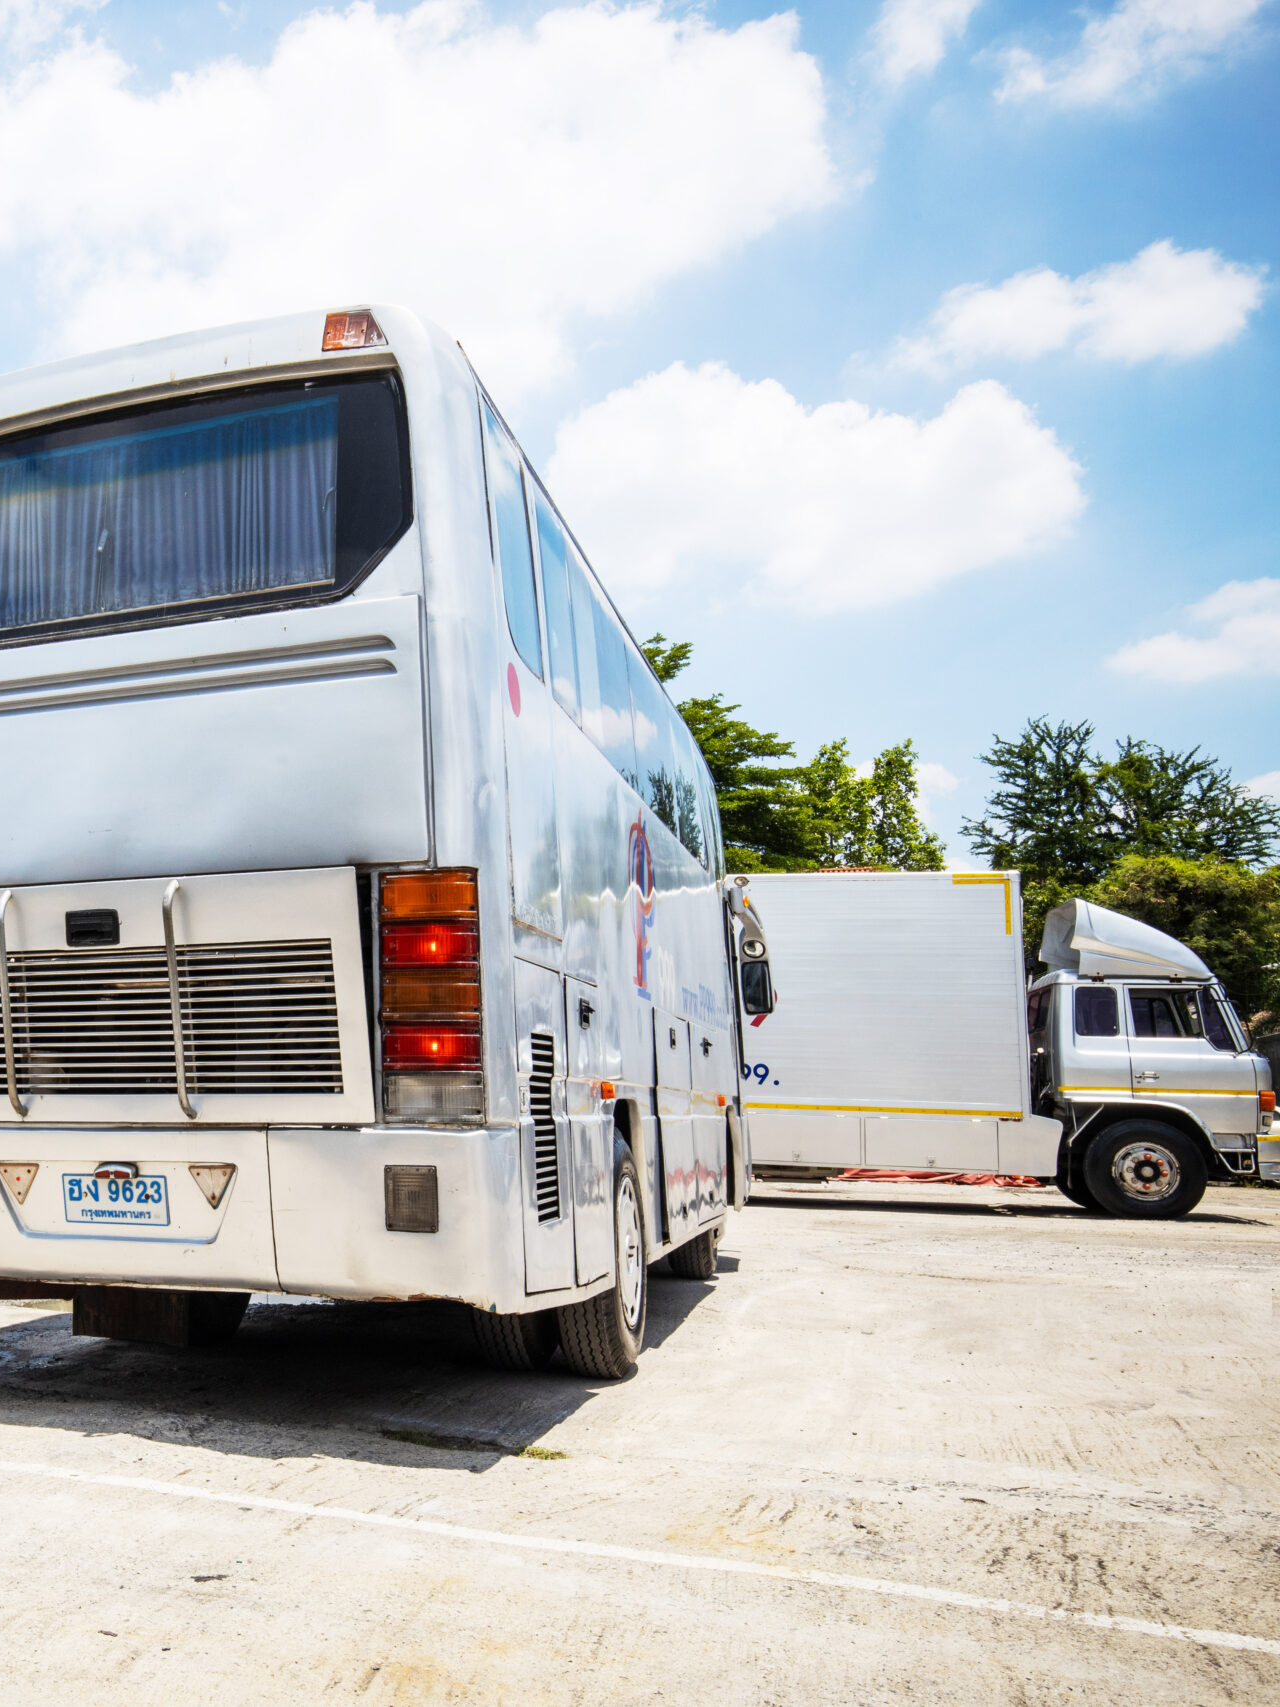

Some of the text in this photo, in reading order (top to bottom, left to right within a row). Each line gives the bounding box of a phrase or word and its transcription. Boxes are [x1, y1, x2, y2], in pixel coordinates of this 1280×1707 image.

[107, 1179, 163, 1204] 9623
[81, 1208, 152, 1221] กรุงเทพมหานคร
